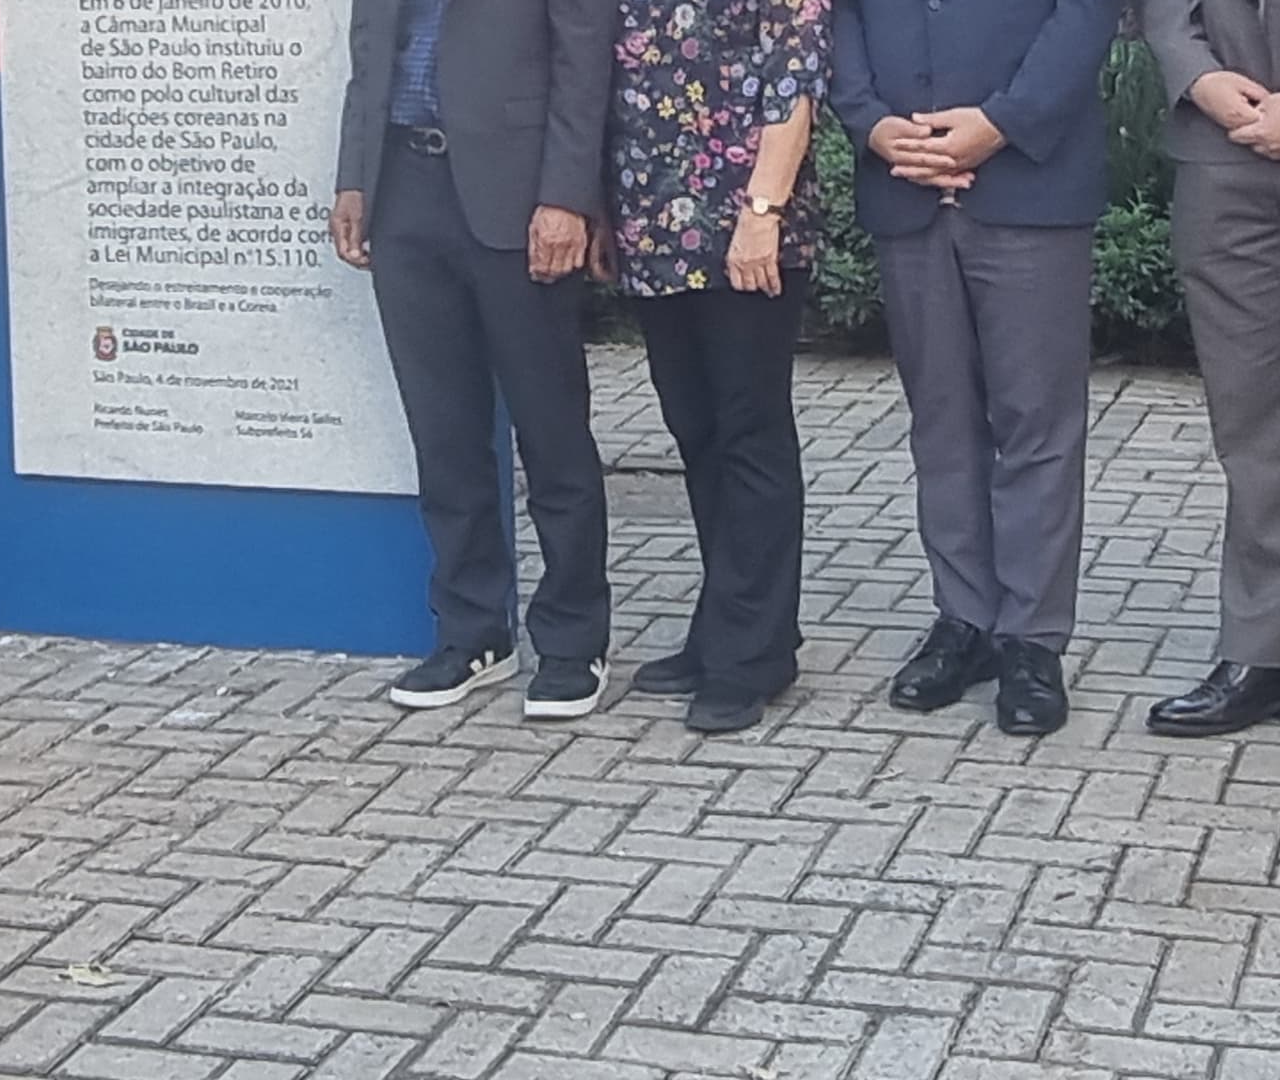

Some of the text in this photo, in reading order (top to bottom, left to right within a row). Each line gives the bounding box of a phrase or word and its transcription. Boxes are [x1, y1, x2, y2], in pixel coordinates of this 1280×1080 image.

[80, 14, 266, 37] a Câmara Municipal
[80, 38, 302, 57] de São Paulo instituiu o
[82, 60, 278, 80] bairro do Bom Retiro
[82, 83, 299, 106] como polo cultural das
[83, 107, 288, 129] tradições coreanas na
[84, 129, 278, 152] cidade de São Paulo,
[85, 153, 256, 176] com o objetivo de
[86, 176, 308, 201] ampliar a integração da
[87, 200, 331, 222] sociedade paulistana e do
[87, 221, 193, 243] imigrantes,
[196, 223, 222, 242] de
[226, 224, 292, 243] acordo
[89, 248, 100, 263] a
[104, 245, 131, 263] Lei
[136, 245, 228, 268] Municipal
[184, 298, 215, 311] Brasil
[161, 329, 175, 339] DE
[122, 339, 200, 355] SÃO PAULO
[155, 374, 164, 385] 4
[166, 374, 181, 386] de
[269, 377, 299, 391] 2021
